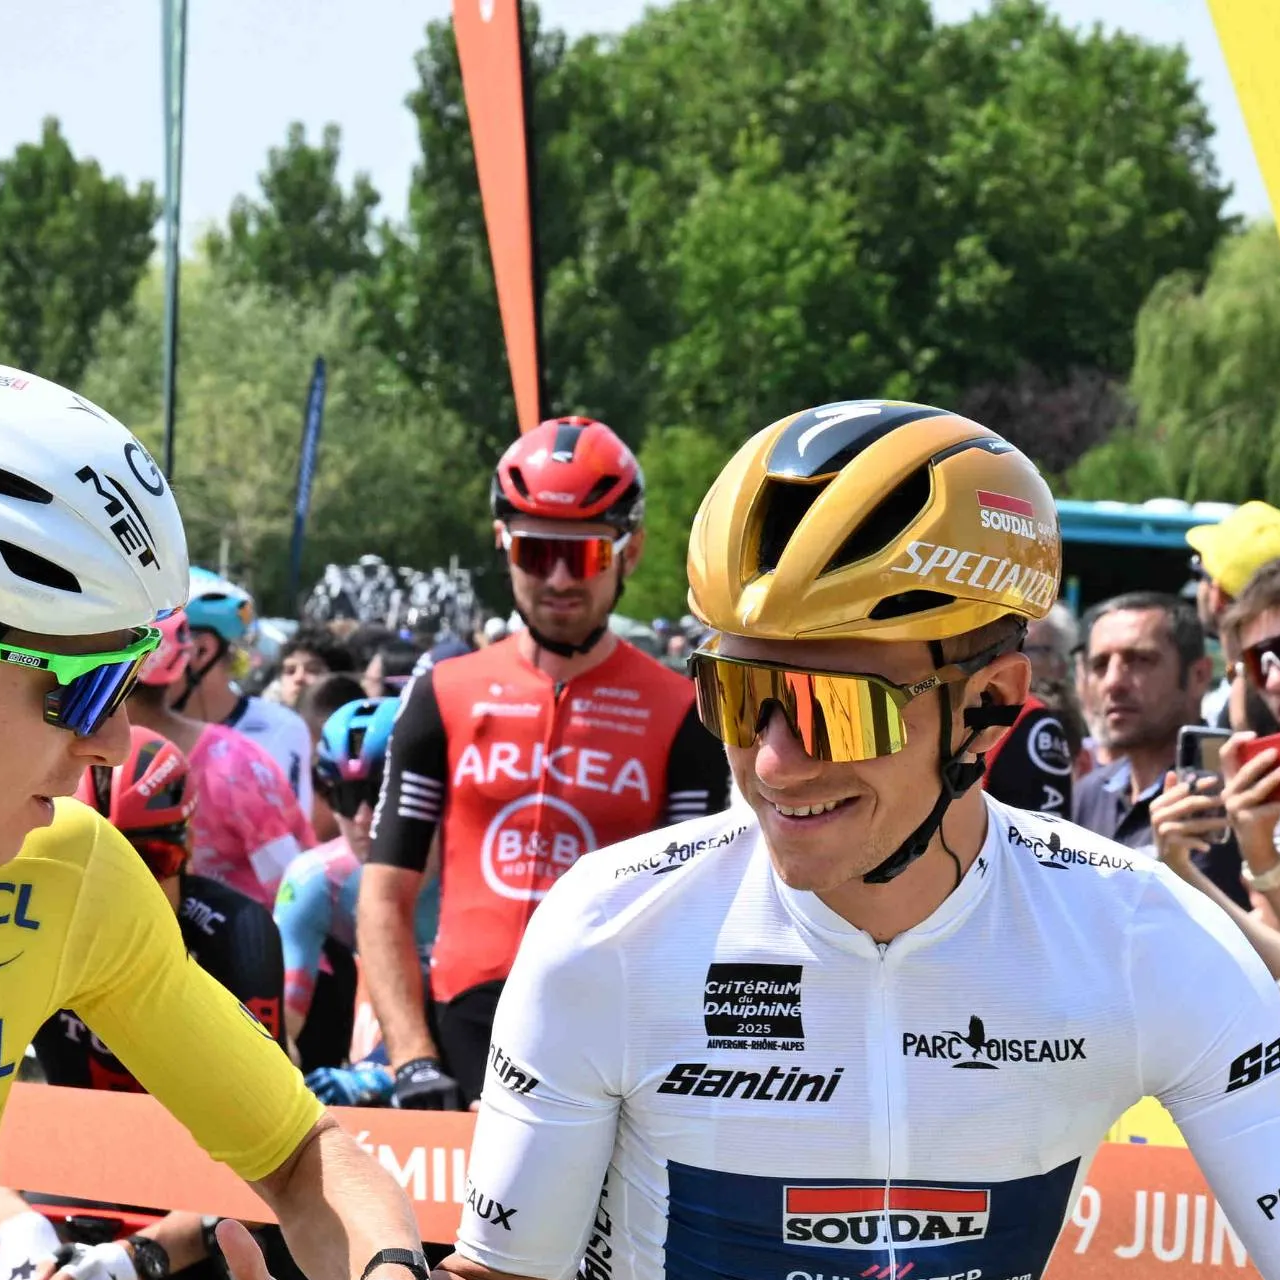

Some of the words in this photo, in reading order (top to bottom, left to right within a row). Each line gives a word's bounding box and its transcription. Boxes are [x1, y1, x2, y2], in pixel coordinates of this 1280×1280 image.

[75, 465, 161, 570] MET
[981, 510, 1036, 540] SOUDAL
[738, 993, 753, 1004] du
[737, 1022, 772, 1035] 2025
[902, 1032, 962, 1060] PARC
[987, 1037, 1086, 1063] OISEAUX
[657, 1063, 844, 1102] Santini
[785, 1212, 983, 1246] SOUDAL
[1072, 1185, 1101, 1255] 9
